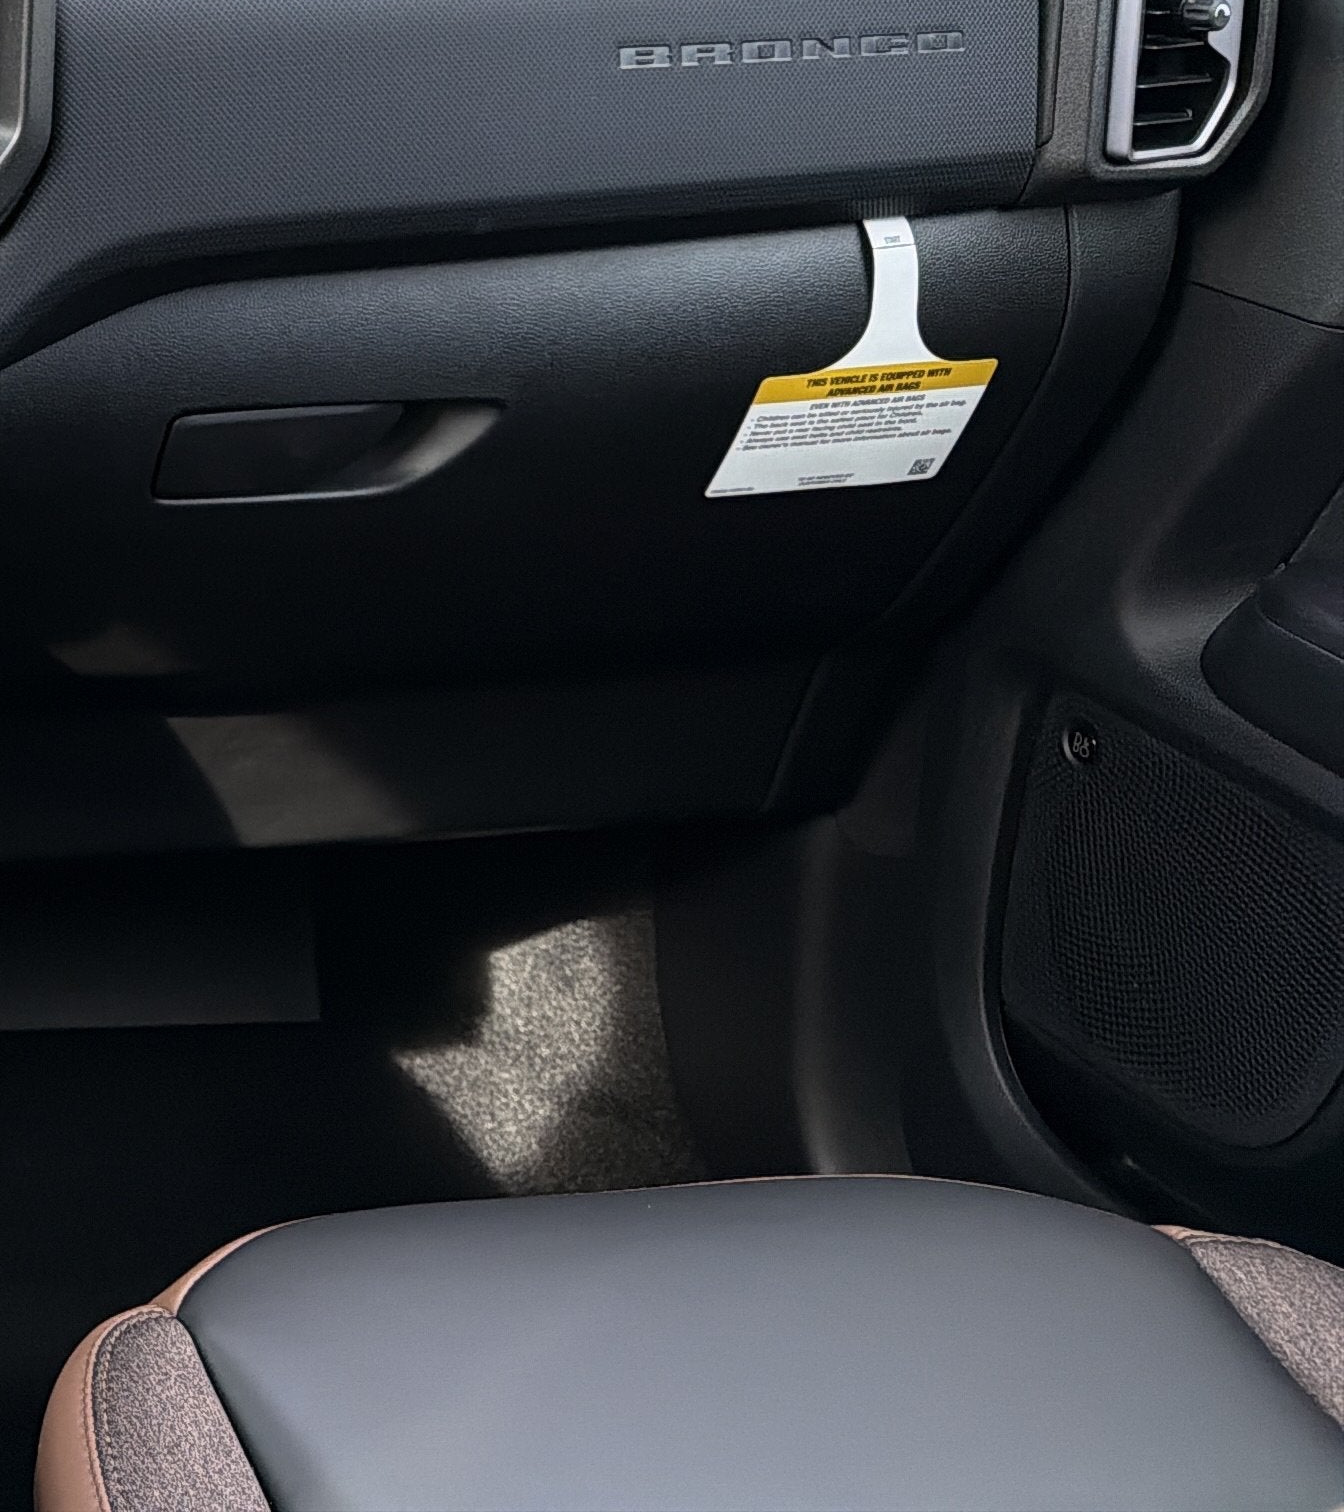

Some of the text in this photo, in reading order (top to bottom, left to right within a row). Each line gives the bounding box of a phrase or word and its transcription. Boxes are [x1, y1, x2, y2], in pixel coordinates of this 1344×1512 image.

[617, 29, 966, 70] BRONCO
[806, 367, 952, 388] THIS VEHICLE IS EQUIPPED WITH
[826, 381, 921, 397] ADVANCED AIR BAGS
